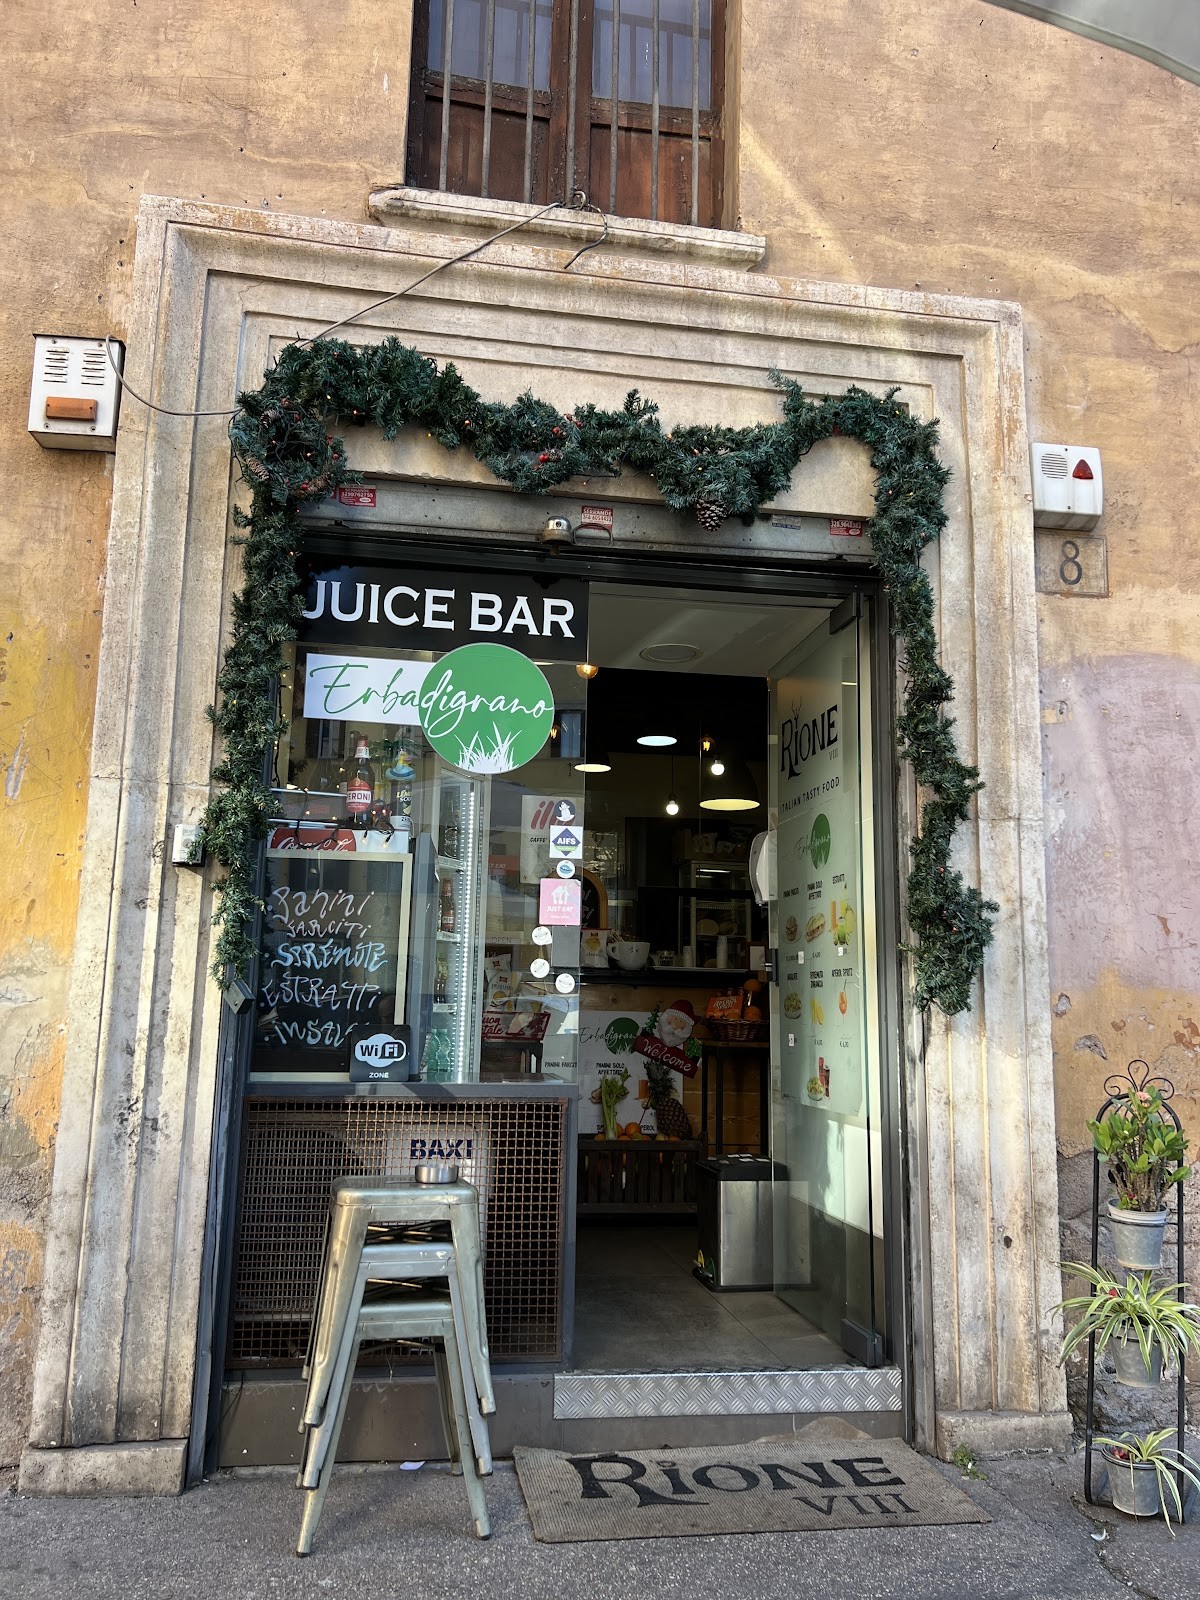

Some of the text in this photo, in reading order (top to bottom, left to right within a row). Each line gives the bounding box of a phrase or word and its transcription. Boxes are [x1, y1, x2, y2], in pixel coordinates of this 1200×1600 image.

[1060, 540, 1083, 585] 8
[303, 580, 575, 638] JUICE BAR
[310, 663, 554, 738] Erbadigrano
[347, 792, 371, 801] ERONI
[803, 786, 821, 803] TASTY
[822, 776, 840, 794] FOOD
[483, 1016, 501, 1025] uon
[578, 1026, 638, 1048] Erbadigran
[643, 1039, 692, 1072] Welcome
[410, 1139, 473, 1160] BAXI
[794, 1494, 920, 1518] VIII
